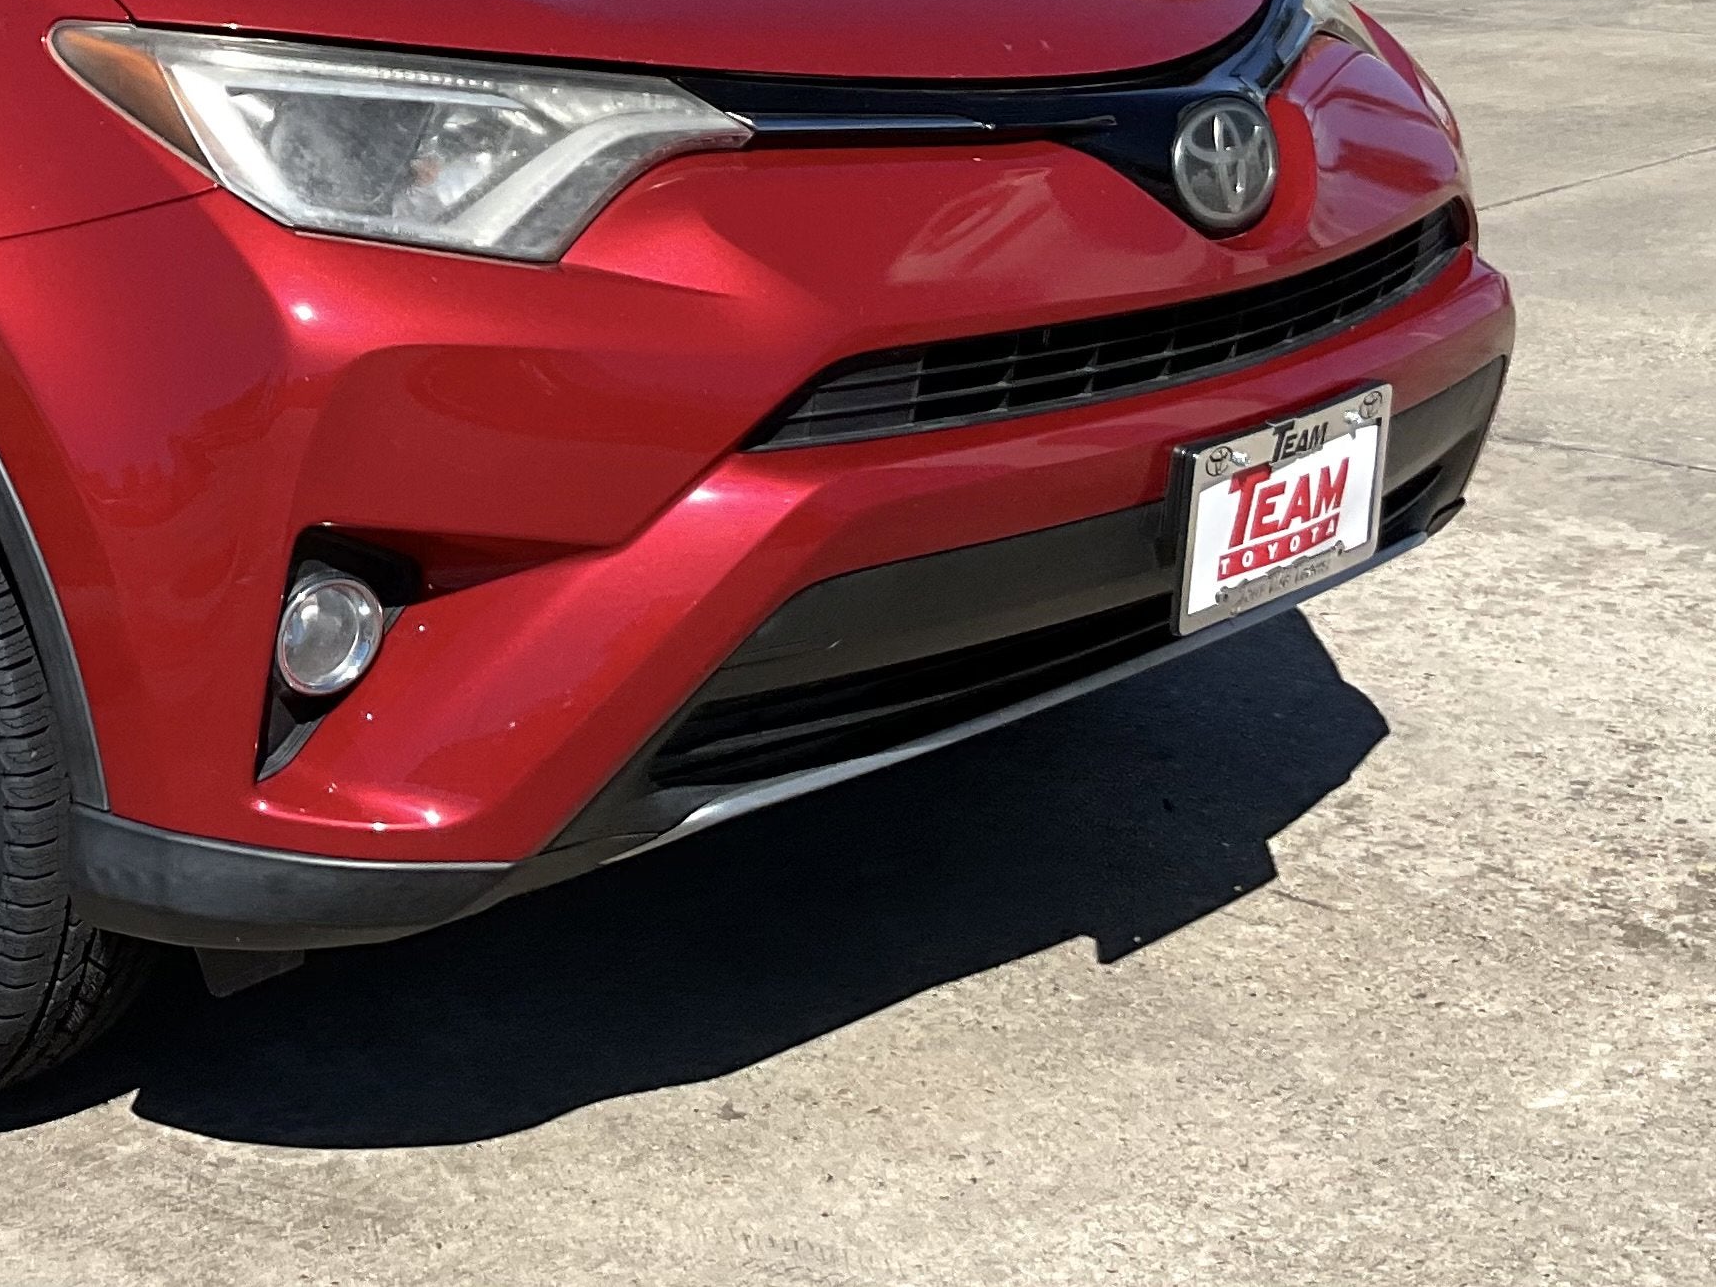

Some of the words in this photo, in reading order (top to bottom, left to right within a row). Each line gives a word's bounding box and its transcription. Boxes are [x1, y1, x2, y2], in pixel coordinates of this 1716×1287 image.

[1272, 420, 1329, 463] TEAM
[1228, 457, 1350, 550] TEAM
[1220, 519, 1336, 575] TOYOTA
